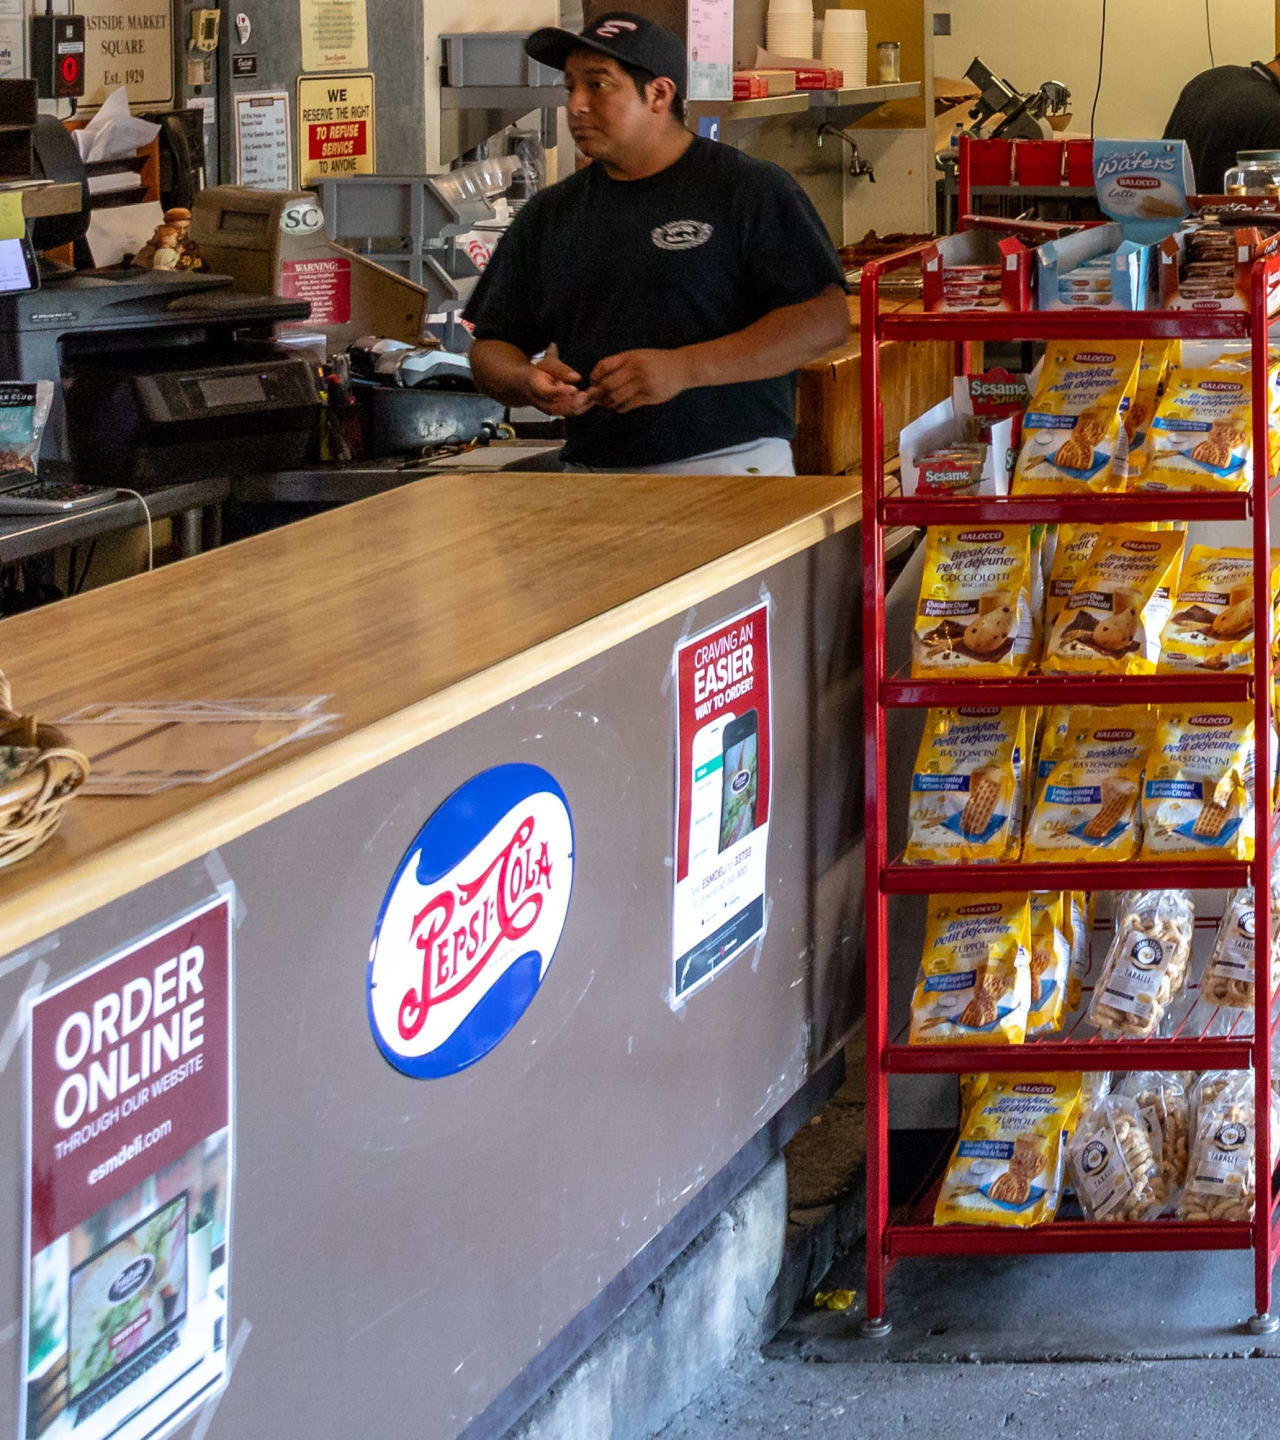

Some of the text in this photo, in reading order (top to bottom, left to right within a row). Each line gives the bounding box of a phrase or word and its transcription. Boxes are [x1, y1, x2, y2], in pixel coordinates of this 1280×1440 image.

[86, 15, 167, 30] ASTSIDE MARKET
[101, 40, 145, 57] SQUARE
[104, 69, 144, 85] Est. 1929
[328, 89, 347, 103] WE
[303, 105, 370, 121] RESERVE THE RIGHT
[316, 123, 359, 140] TO REFUSE
[321, 141, 353, 156] SERVICE
[319, 157, 357, 172] TO ANYONE
[1119, 179, 1158, 187] BALOCCO
[1108, 189, 1137, 199] Latte
[285, 209, 318, 228] SC
[295, 262, 338, 273] WARNING:
[1076, 353, 1115, 362] BALOCCO
[1063, 367, 1114, 380] Breakfast
[971, 381, 1028, 397] Sesame
[1201, 382, 1241, 391] BALOCCO
[925, 469, 970, 482] Sesame
[960, 532, 1002, 541] BALOCCO
[950, 545, 1006, 562] Breakfast
[936, 556, 1016, 573] Petit déjeuner
[941, 572, 1010, 583] GOCCIOLOTTI
[695, 621, 753, 668] CRAVING AN
[694, 643, 753, 703] EASIER
[695, 676, 754, 721] WAY TO ORDER?
[1190, 715, 1231, 725] BALOCCO
[949, 722, 1000, 736] Breakfast
[1096, 730, 1133, 740] BALOCCO
[932, 732, 1008, 748] Petit déjeuner
[1178, 731, 1231, 743] Breakfast
[939, 748, 998, 758] BASTONCINI
[1161, 740, 1240, 753] Petit déjeuner
[1170, 754, 1230, 766] BASTONCINI
[702, 866, 726, 890] ESMDELI
[946, 916, 1002, 933] Breakfast
[964, 925, 1011, 940] déjeuner
[1124, 968, 1151, 984] TARALLI
[55, 945, 205, 1072] ORDER
[54, 997, 205, 1130] ONLINE
[1015, 1084, 1055, 1093] BALOCCO
[54, 1053, 204, 1161] THROUGH OUR WEBSITE
[87, 1119, 172, 1187] esmdeli.com
